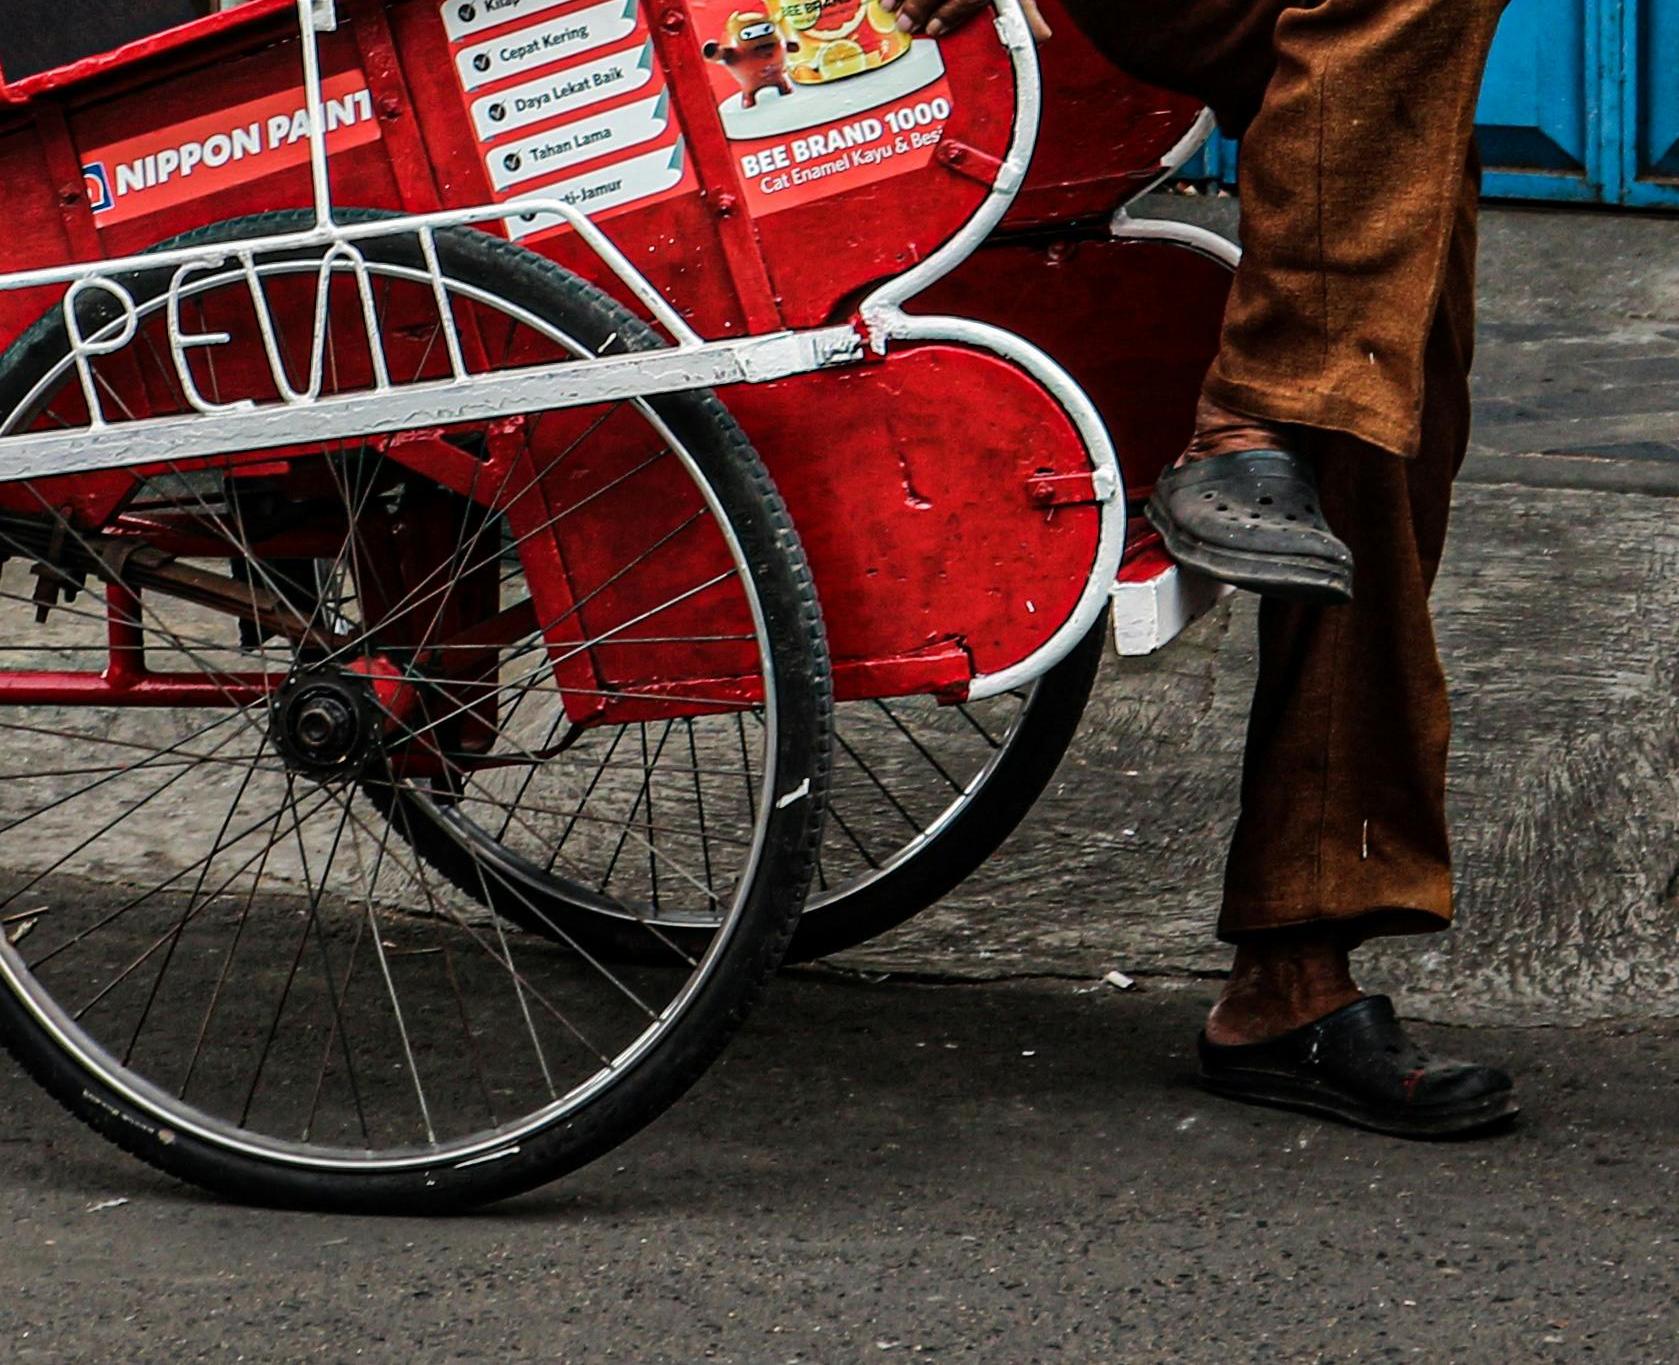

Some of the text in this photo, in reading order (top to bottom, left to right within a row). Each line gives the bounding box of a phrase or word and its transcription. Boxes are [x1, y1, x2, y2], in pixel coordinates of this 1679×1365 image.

[500, 23, 591, 63] Cepat Kering
[515, 67, 625, 114] Daya Lekat Baik
[115, 120, 261, 196] NIPPON
[529, 126, 613, 163] Tahan Lama
[740, 97, 951, 179] BEE BRAND 1000
[760, 169, 791, 194] Cat
[793, 153, 850, 186] Enamel
[853, 141, 893, 165] Kayu
[895, 136, 910, 154] &
[559, 179, 623, 205] ti-Jamur
